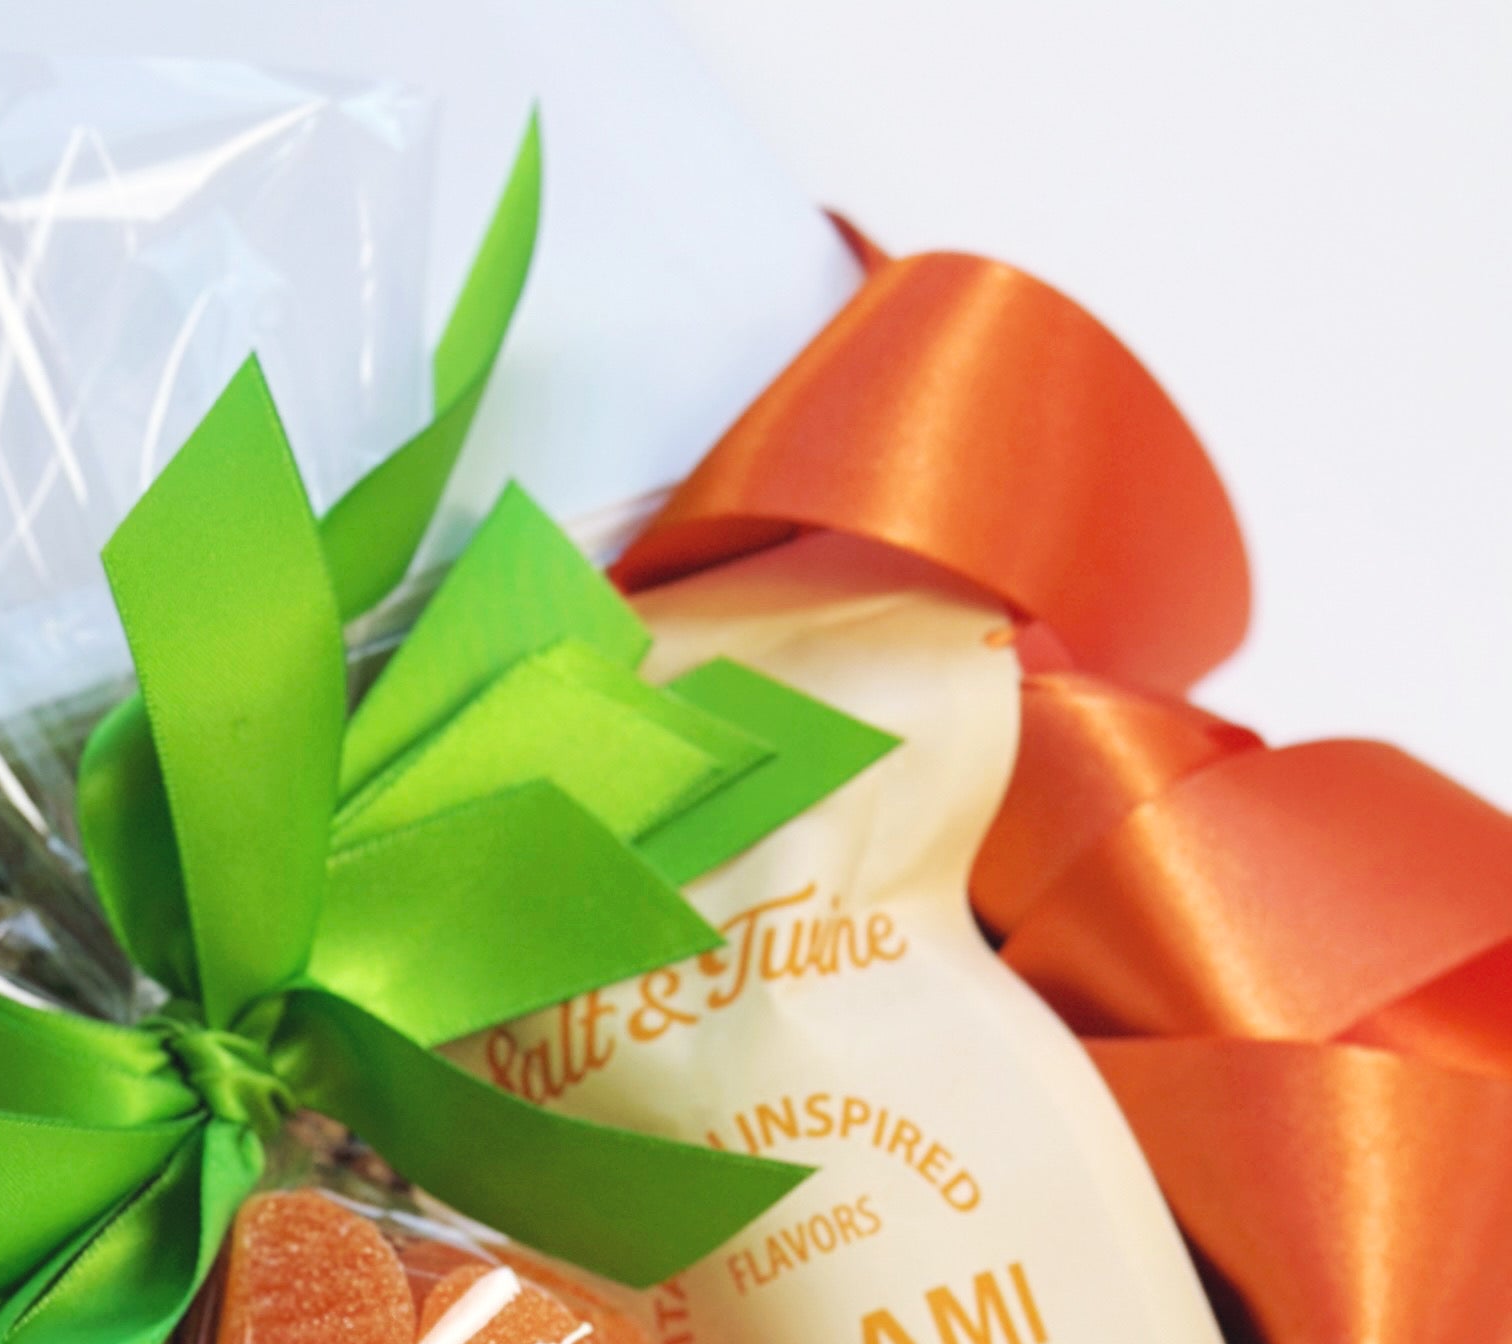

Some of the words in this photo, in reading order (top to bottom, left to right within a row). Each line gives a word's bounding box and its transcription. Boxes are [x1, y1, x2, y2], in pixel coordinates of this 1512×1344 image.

[628, 966, 699, 1043] &
[697, 882, 908, 1011] Twine
[734, 1091, 982, 1214] INSPIRED
[726, 1193, 883, 1298] FLAVORS
